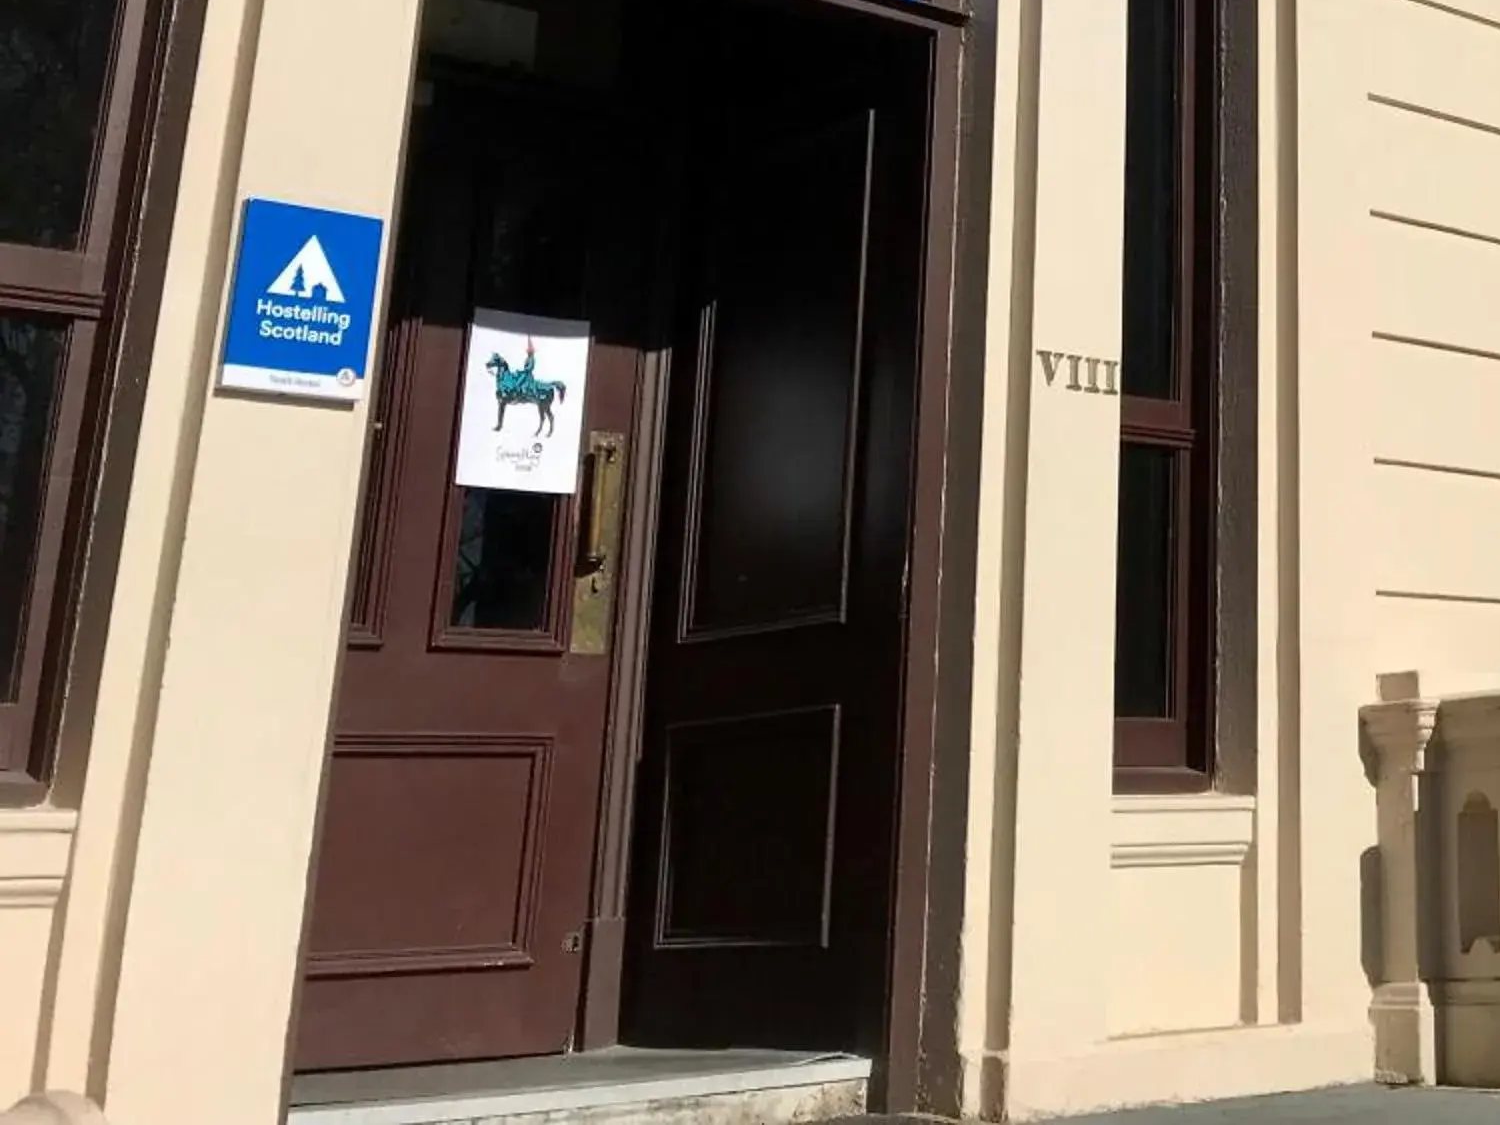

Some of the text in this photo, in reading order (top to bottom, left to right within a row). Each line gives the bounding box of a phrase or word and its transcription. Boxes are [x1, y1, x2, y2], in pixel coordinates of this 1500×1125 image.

[256, 298, 351, 330] Hostelling
[259, 319, 343, 346] Scotland
[1036, 349, 1119, 396] VIII
